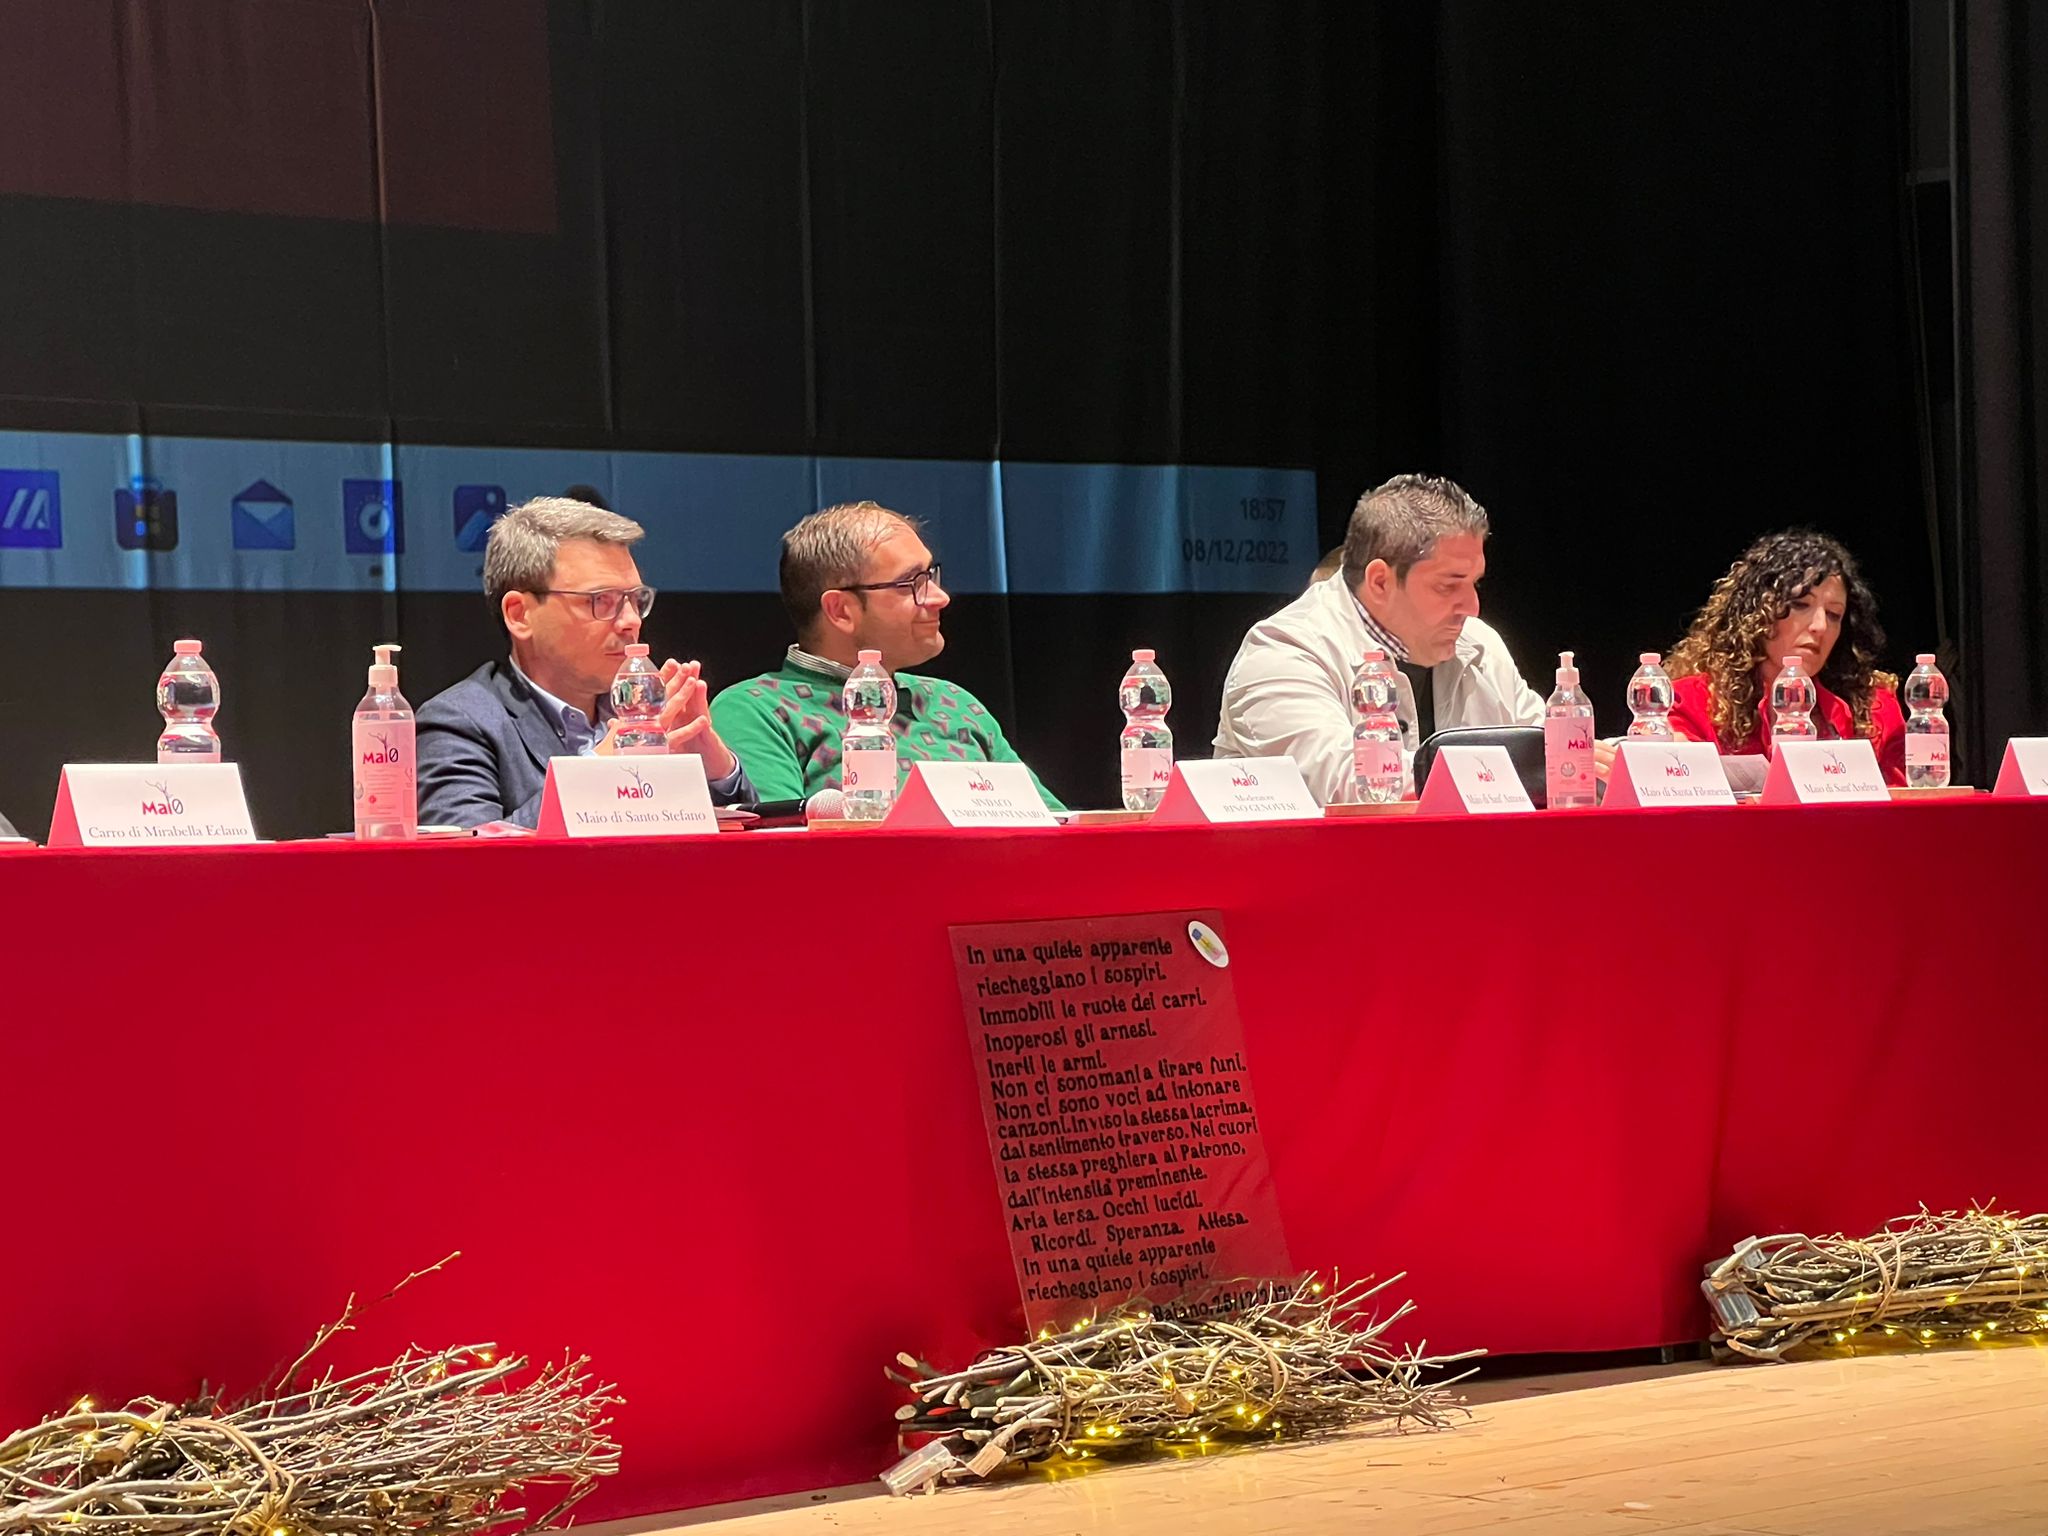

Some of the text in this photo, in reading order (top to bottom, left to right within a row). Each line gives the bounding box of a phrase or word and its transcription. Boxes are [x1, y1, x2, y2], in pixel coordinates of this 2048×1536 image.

[1182, 538, 1289, 566] 08/12/2022
[88, 824, 248, 839] Carro di Mirabella Eclano
[576, 809, 706, 824] Maio di Santo Stefano
[966, 937, 1173, 965] In una quiete apparente
[976, 969, 1087, 998] riecheggiano
[1104, 961, 1167, 988] sospiri.
[978, 999, 1056, 1026] Immobili
[1061, 999, 1077, 1019] le
[1082, 994, 1127, 1017] ruote
[1162, 986, 1207, 1010] carri.
[984, 1017, 1157, 1056] Inoperosi gli arnesi.
[986, 1049, 1107, 1079] Inerti le armi.
[991, 1079, 1029, 1100] Non
[1034, 1073, 1050, 1096] ci
[1158, 1058, 1204, 1079] tirare
[1210, 1052, 1247, 1075] funi.
[994, 1079, 1241, 1122] Non ci sono voci ad intonare
[1123, 1108, 1140, 1127] la
[1141, 1106, 1190, 1126] stessa
[1190, 1098, 1253, 1120] lacrima.
[1000, 1140, 1027, 1162] dal
[1029, 1132, 1116, 1158] sentimento
[1118, 1126, 1189, 1148] traverso.
[1218, 1115, 1258, 1136] cuori
[1003, 1165, 1021, 1184] la
[1027, 1162, 1079, 1182] stessa
[1081, 1149, 1158, 1178] preghiera
[1163, 1143, 1178, 1164] al
[1116, 1163, 1208, 1198] preminente.
[1012, 1189, 1204, 1233] Aria tersa. Occhi lucidi.
[1030, 1211, 1249, 1254] Ricordi. Speranza. Attesa.
[1022, 1236, 1217, 1277] In una quiete apparente
[1027, 1274, 1133, 1302] riecheggiano
[1150, 1261, 1209, 1288] sospiri.
